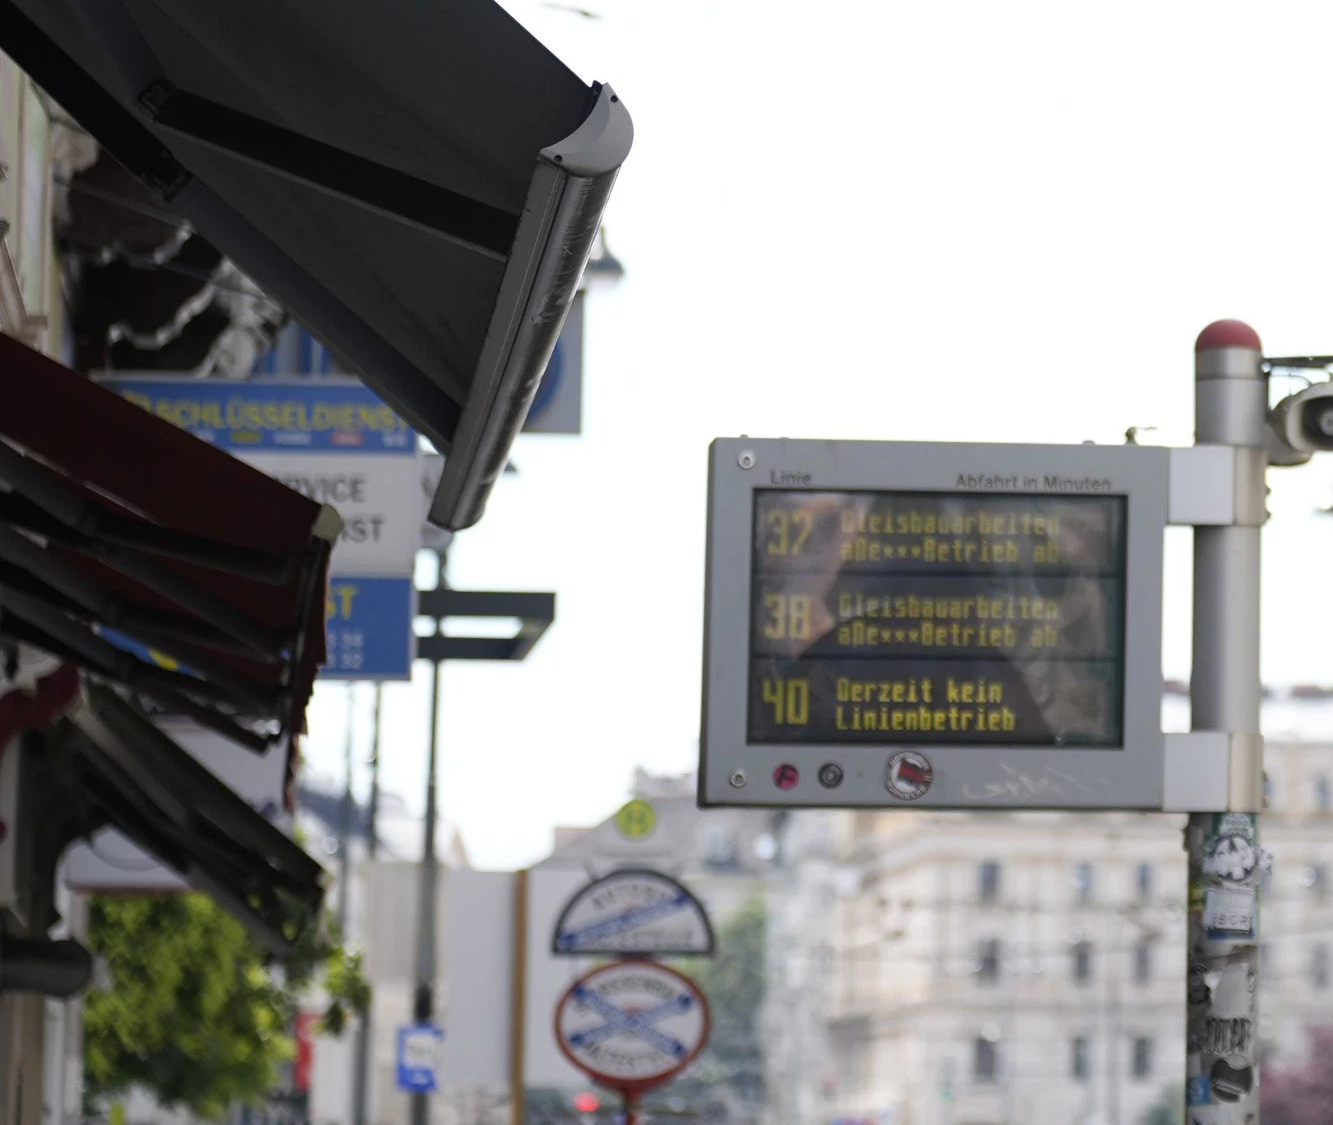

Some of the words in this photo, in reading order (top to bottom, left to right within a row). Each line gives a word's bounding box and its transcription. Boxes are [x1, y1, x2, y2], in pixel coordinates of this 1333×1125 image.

[770, 470, 813, 486] Linie
[955, 473, 1018, 490] Abfahrt
[1023, 474, 1037, 490] in
[1044, 475, 1111, 492] Minuten
[767, 510, 812, 556] 37
[840, 508, 1061, 536] Gleisbauarbeiten
[764, 594, 811, 640] 38
[839, 591, 1060, 619] Gleisbauarbeiten
[1032, 624, 1059, 648] ab
[763, 678, 809, 725] 40
[836, 678, 933, 703] Derzeit
[946, 679, 1001, 704] kein
[835, 707, 1016, 732] Linienbetrieb
